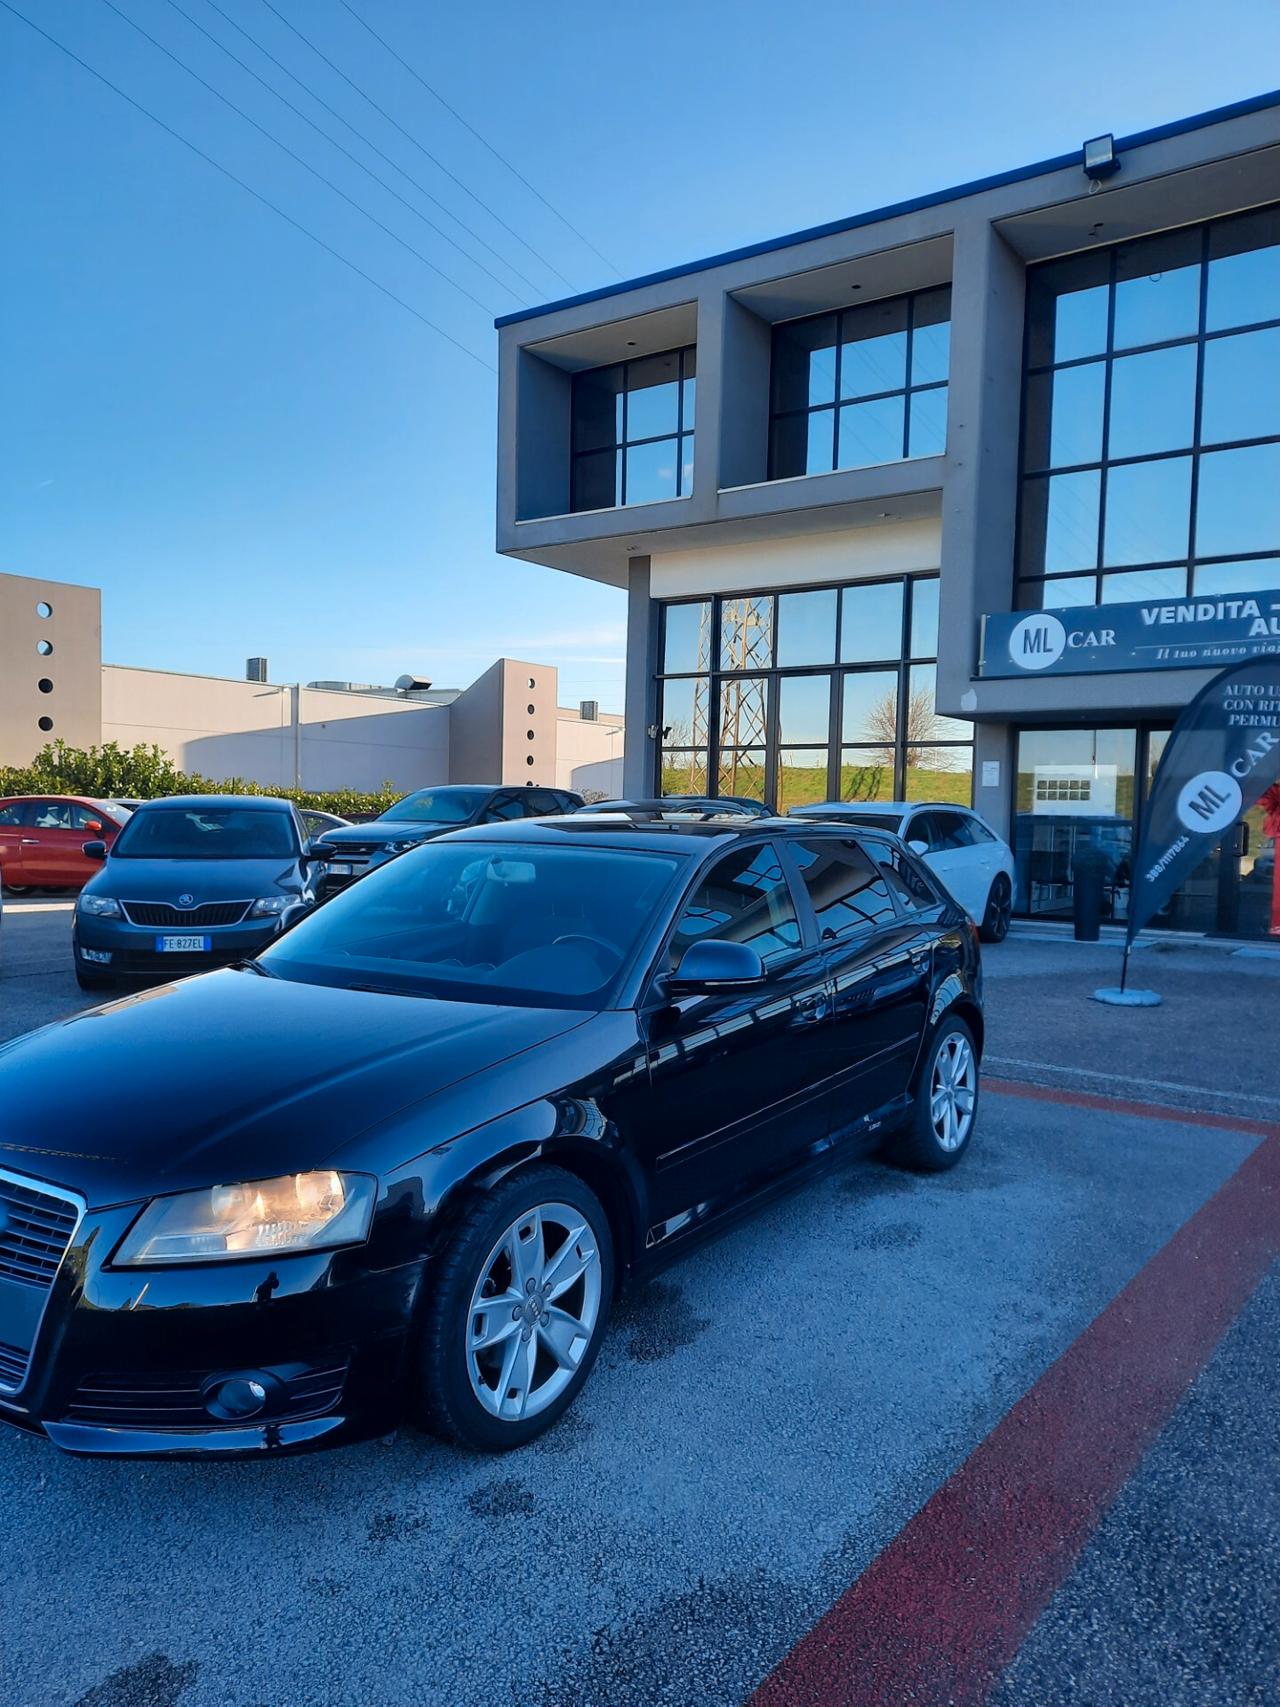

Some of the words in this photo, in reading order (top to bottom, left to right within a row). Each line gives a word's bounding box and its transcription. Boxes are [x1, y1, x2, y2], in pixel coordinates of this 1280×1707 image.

[1141, 599, 1261, 625] VENDITA
[1023, 627, 1054, 654] ML
[1067, 629, 1117, 648] CAR
[1157, 648, 1169, 659] Il
[1173, 648, 1197, 658] tuo
[1202, 646, 1246, 657] nuovo
[1223, 684, 1265, 696] AUTO
[1222, 699, 1256, 710] CON
[1187, 784, 1232, 821] ML
[1231, 732, 1280, 778] CAR
